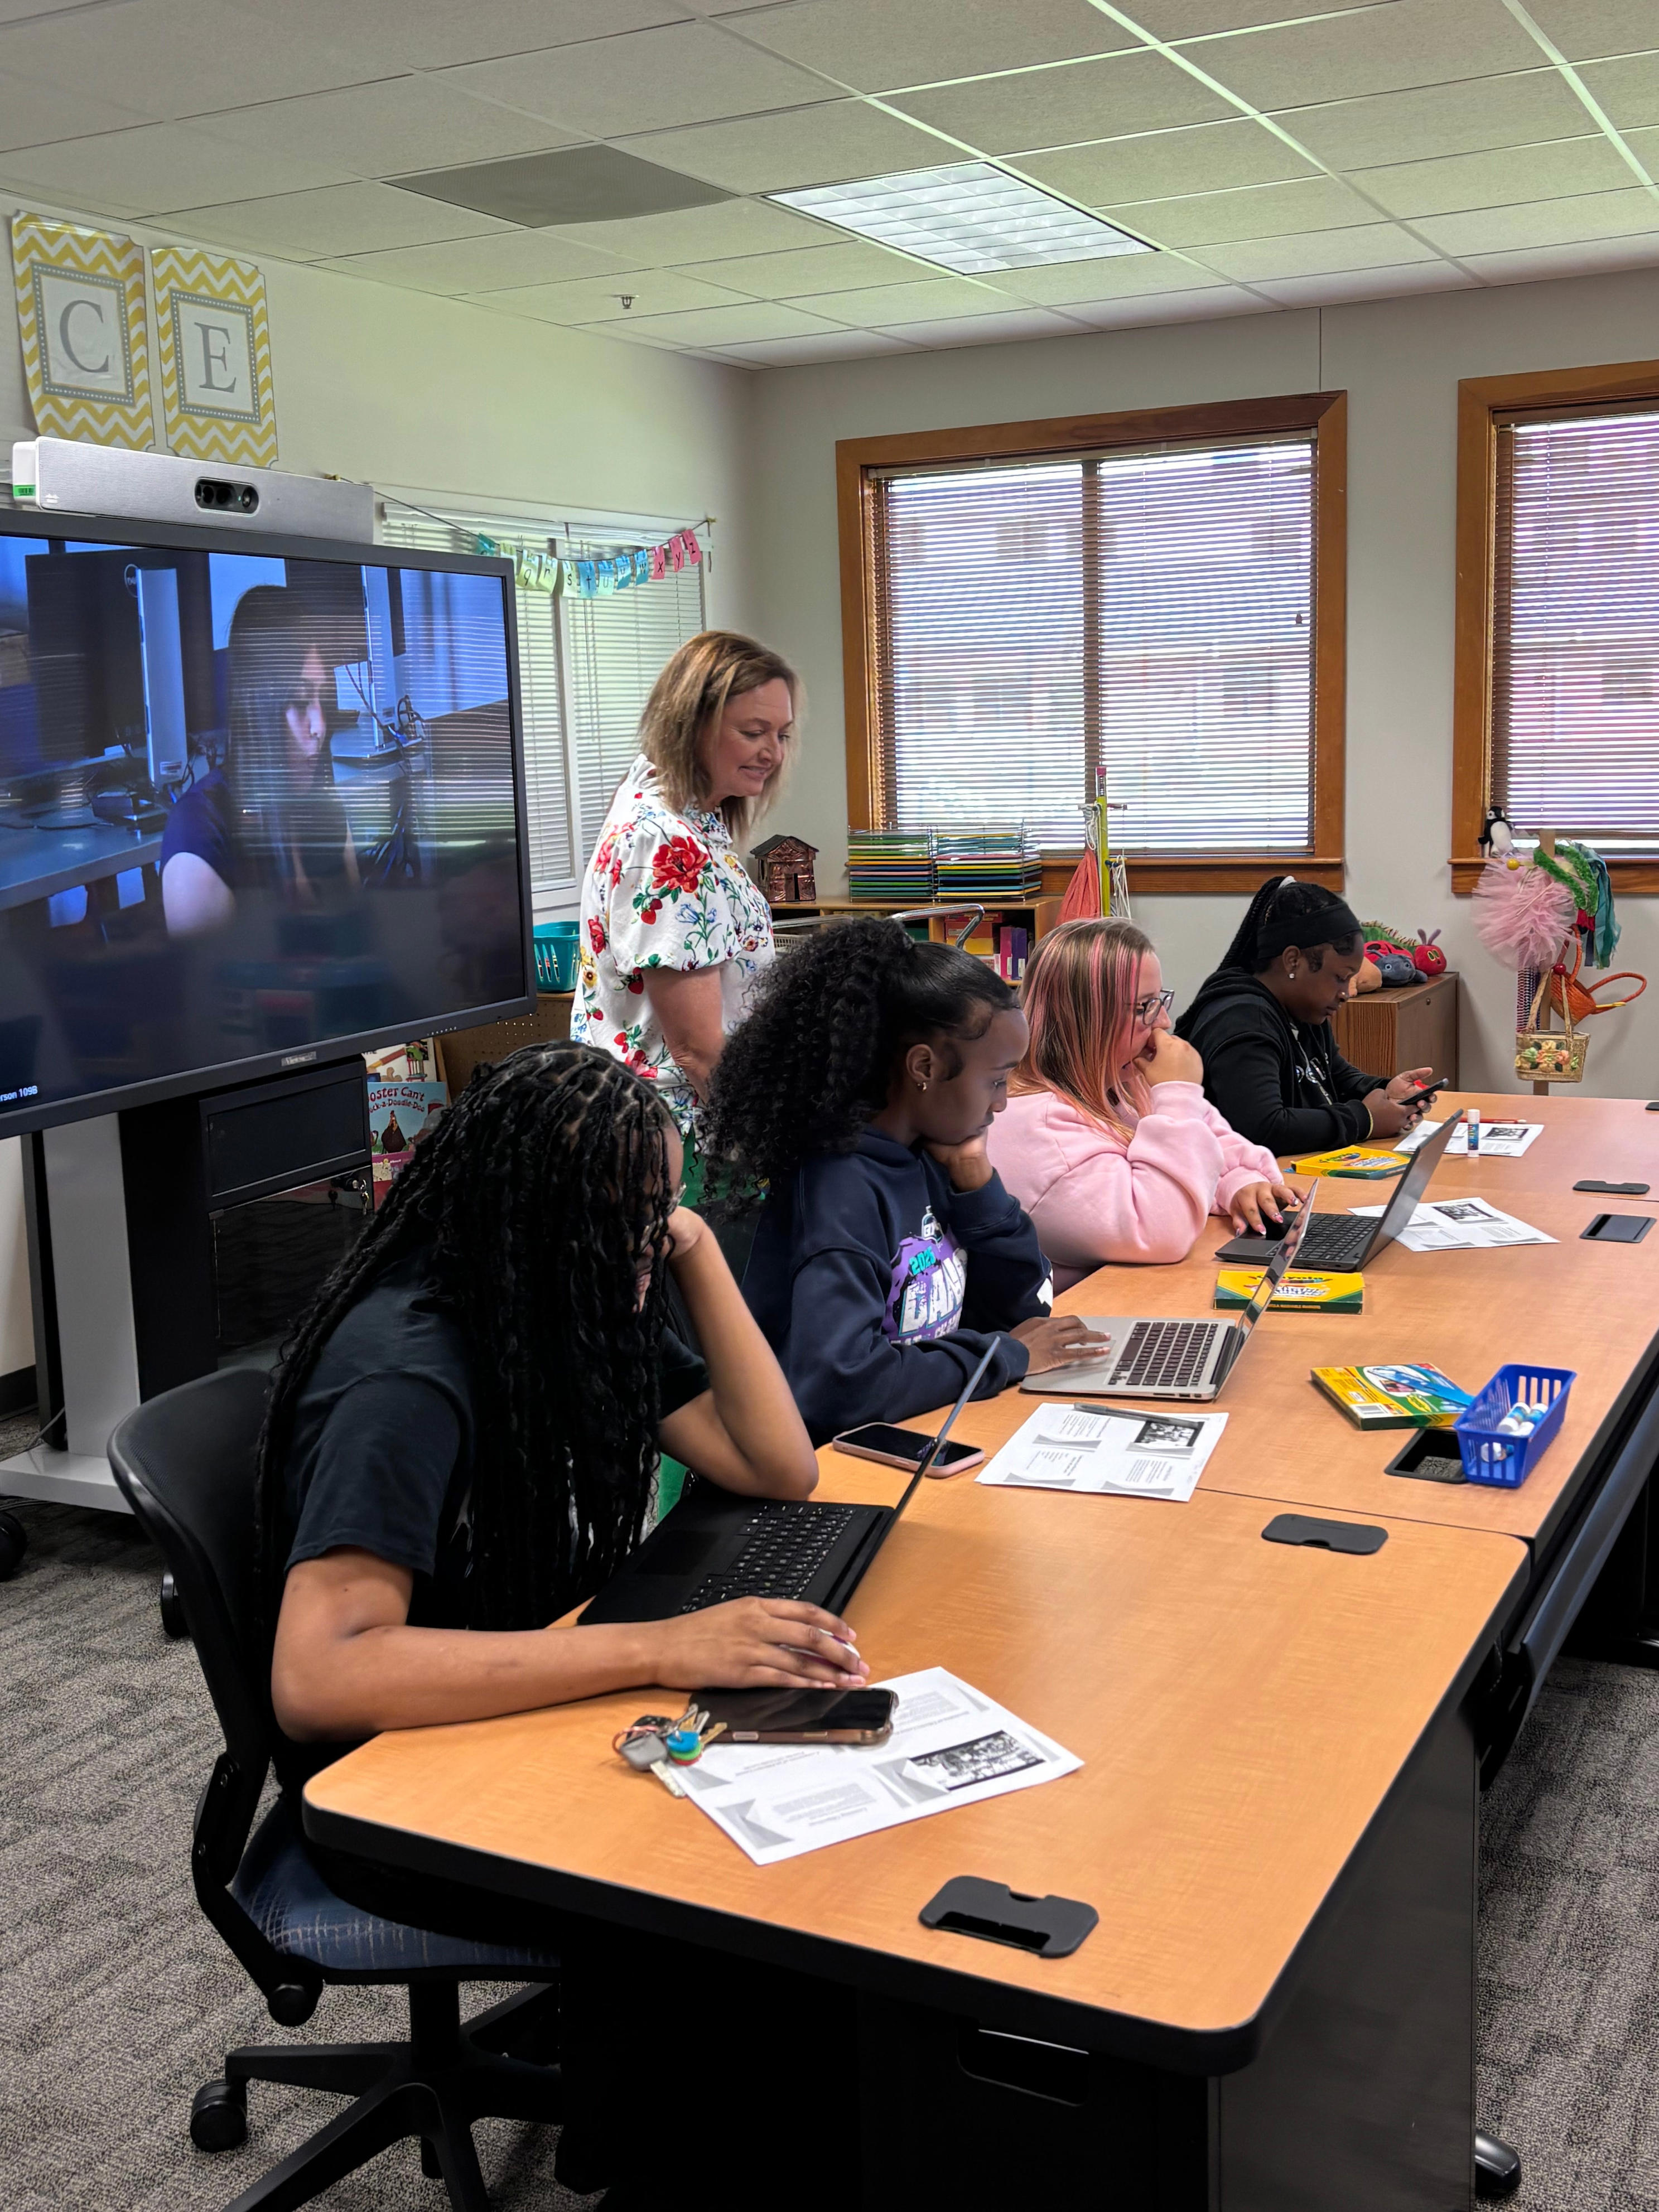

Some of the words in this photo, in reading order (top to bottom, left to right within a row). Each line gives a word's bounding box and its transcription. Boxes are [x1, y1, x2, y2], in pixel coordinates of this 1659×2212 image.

[59, 300, 109, 373] C
[194, 322, 237, 393] E
[544, 567, 550, 578] r
[586, 575, 592, 590] t
[676, 551, 681, 569] y
[0, 1091, 17, 1102] rson
[368, 1087, 398, 1102] oster
[401, 1086, 425, 1102] Can't
